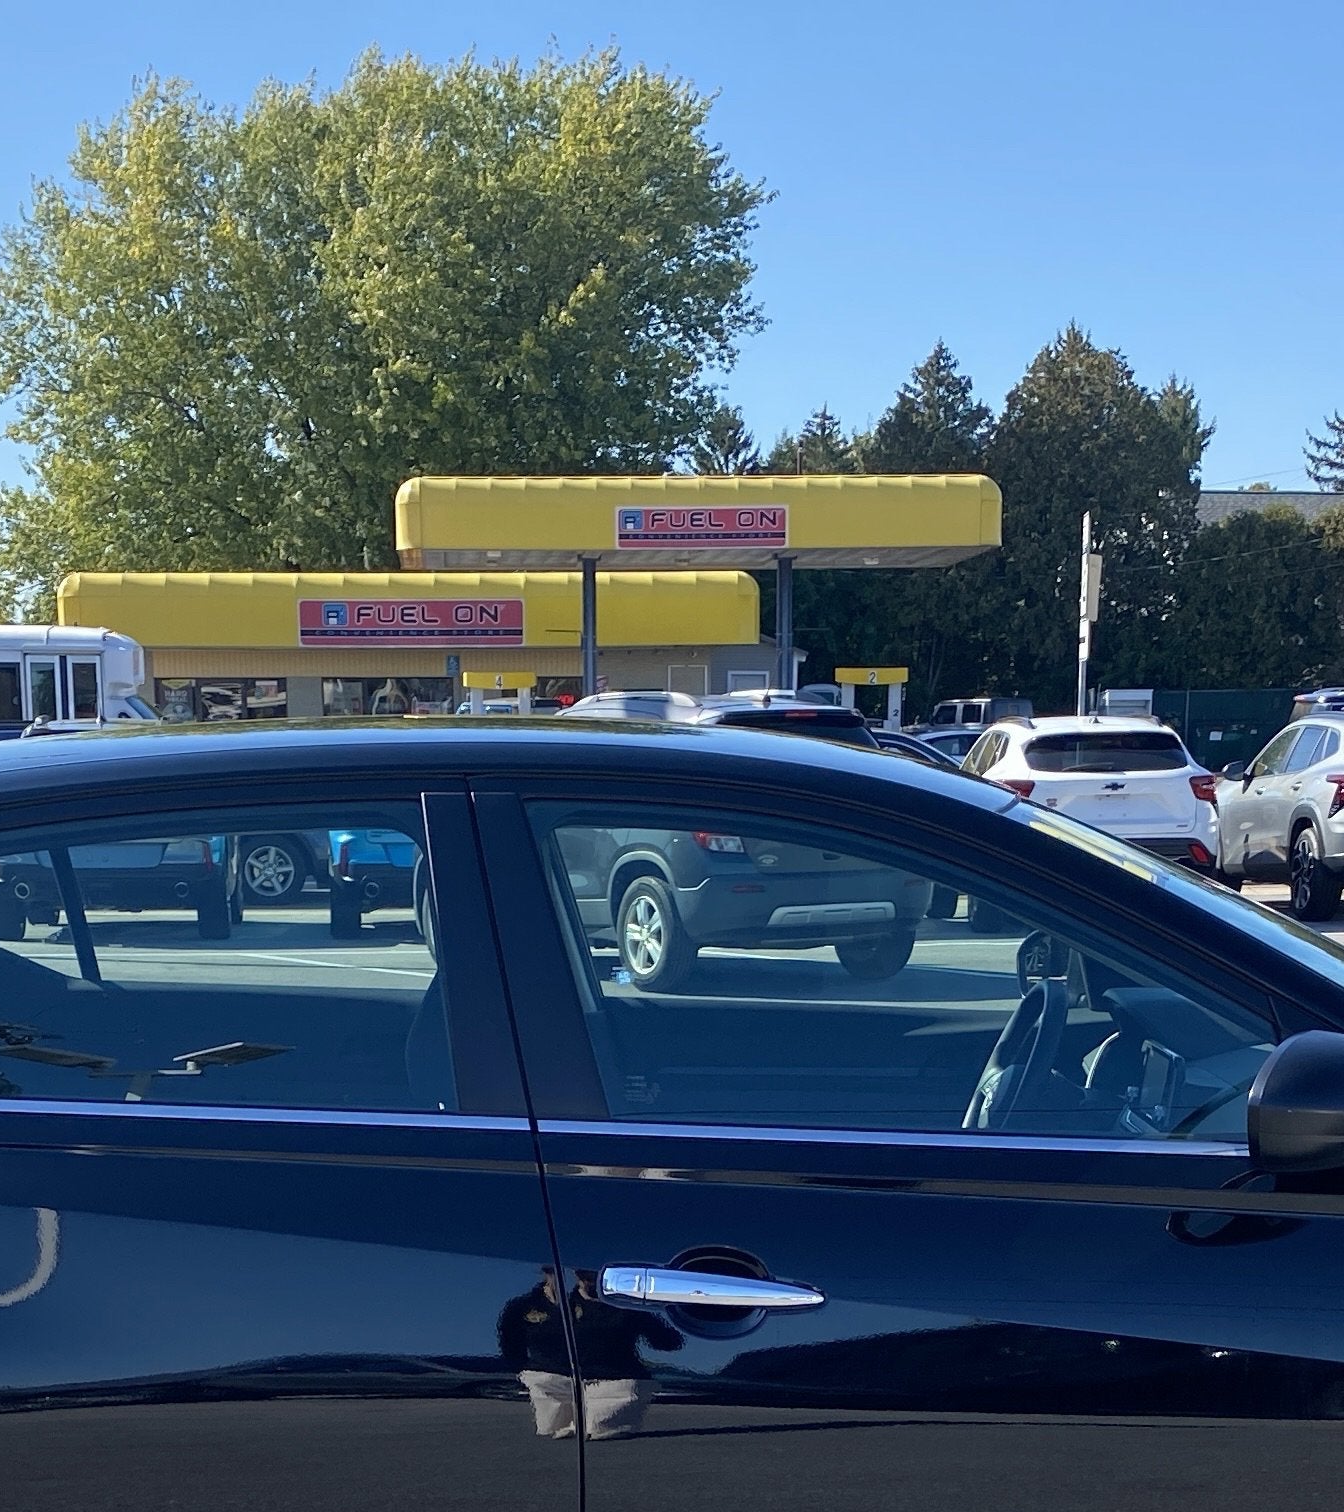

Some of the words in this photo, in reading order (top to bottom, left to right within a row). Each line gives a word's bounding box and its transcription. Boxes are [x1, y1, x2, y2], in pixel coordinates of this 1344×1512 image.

[650, 510, 724, 528] FUEL
[737, 510, 778, 528] ON
[355, 605, 440, 625] FUEL
[453, 604, 501, 624] ON
[495, 674, 504, 688] 4
[869, 671, 877, 684] 2
